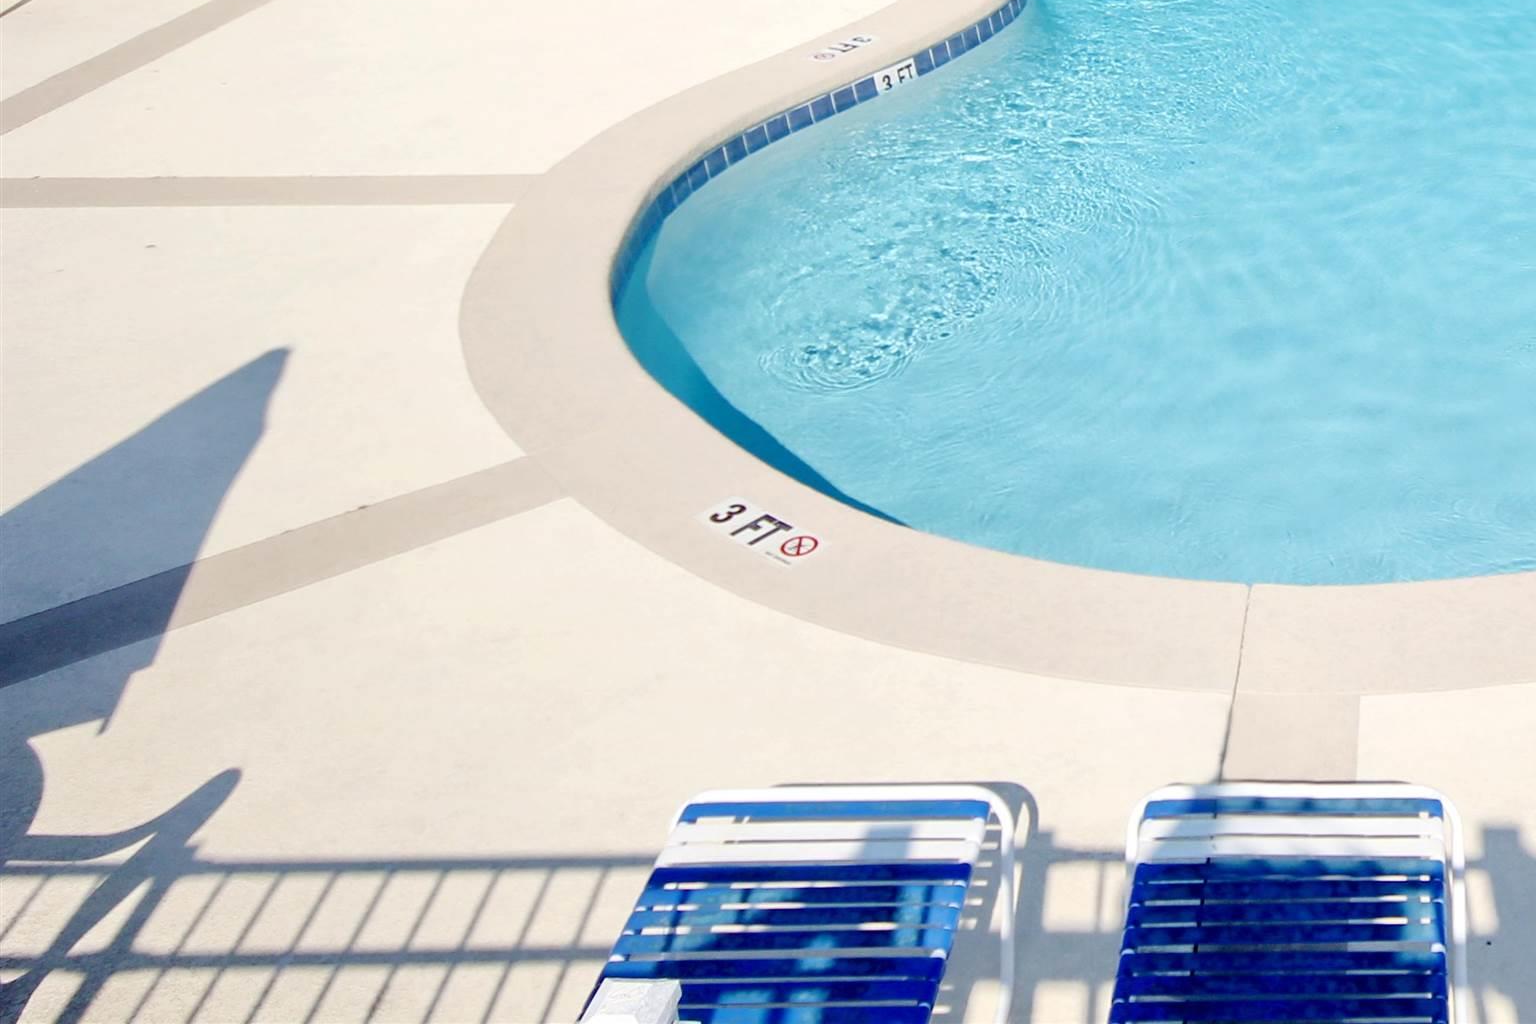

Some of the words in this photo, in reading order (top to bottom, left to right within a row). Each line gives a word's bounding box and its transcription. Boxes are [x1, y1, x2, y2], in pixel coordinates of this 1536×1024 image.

[882, 74, 893, 91] 3
[897, 63, 913, 84] FT
[709, 503, 747, 523] 3
[729, 513, 794, 547] FT
